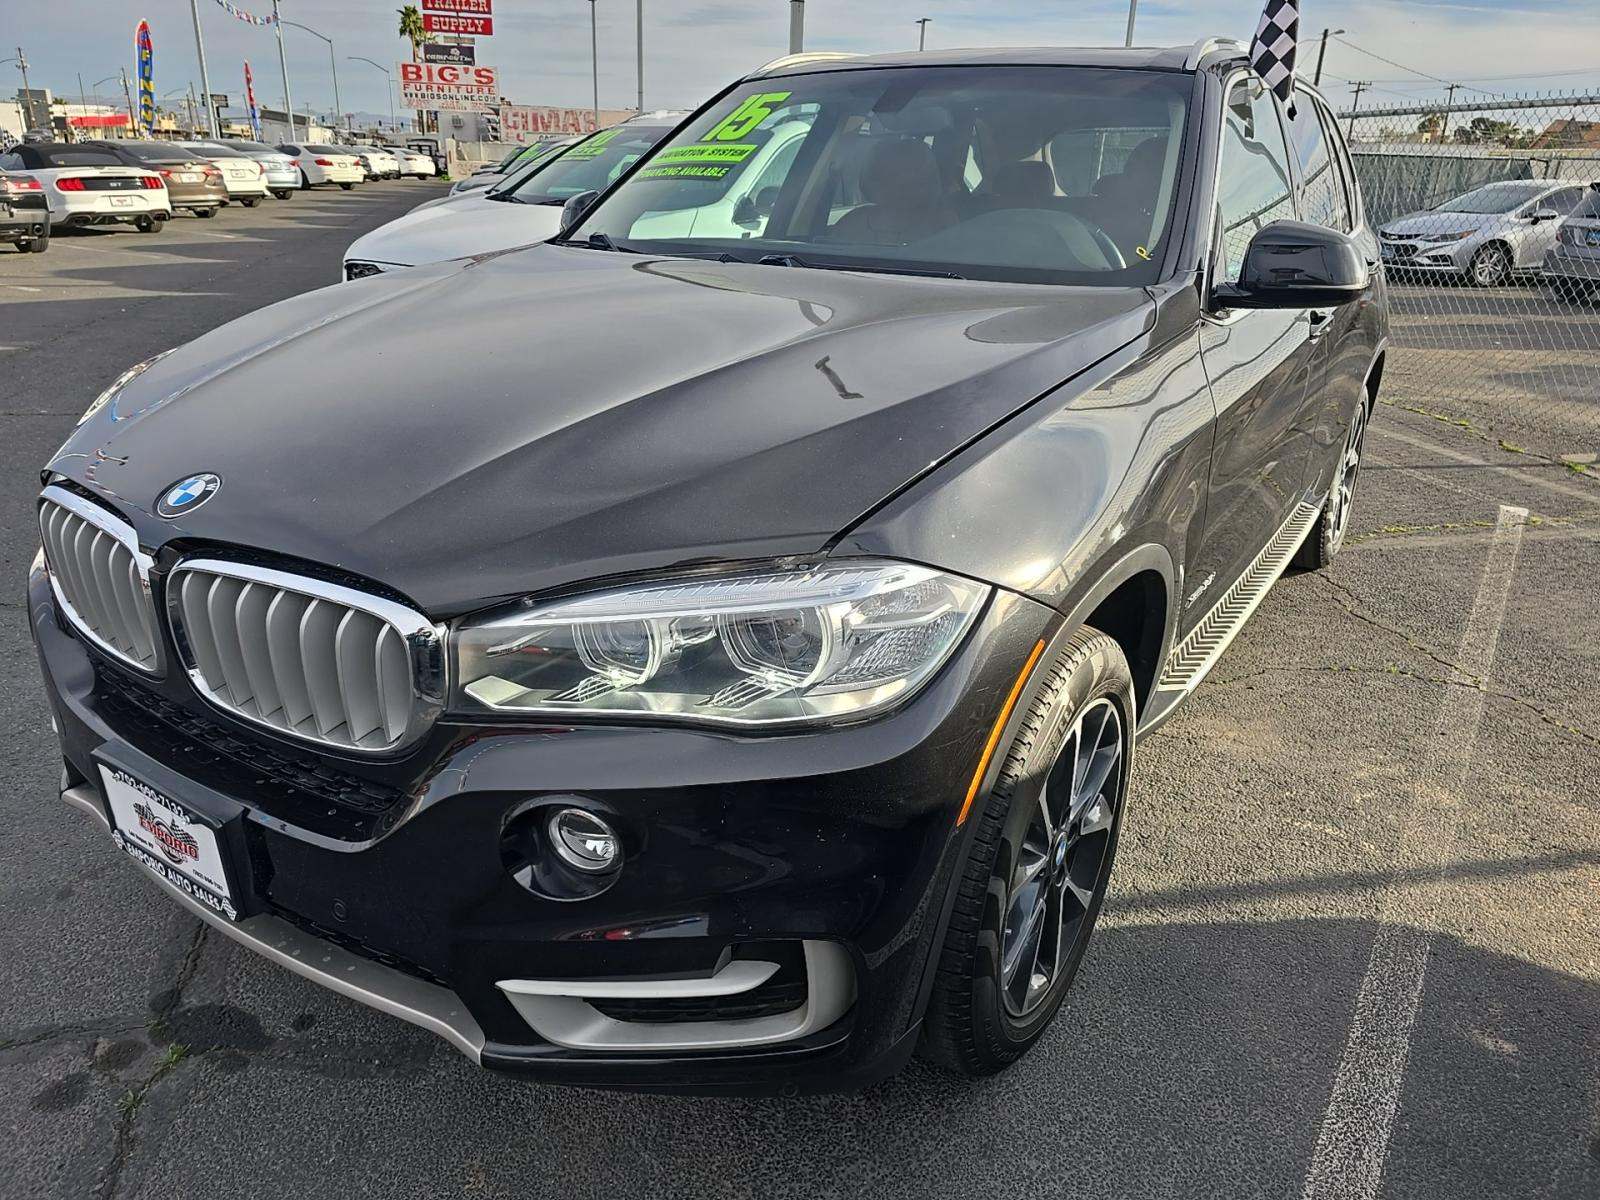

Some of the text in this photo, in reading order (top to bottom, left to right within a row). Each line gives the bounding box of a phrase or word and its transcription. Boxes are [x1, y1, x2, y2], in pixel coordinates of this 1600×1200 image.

[427, 0, 488, 12] TRAILER
[432, 16, 484, 32] SUPPLY
[401, 64, 494, 84] BIG'S
[403, 84, 495, 95] FURNITURE
[699, 92, 792, 141] 15
[708, 147, 750, 157] SYSTEM
[678, 167, 731, 177] AVAILABLE
[140, 816, 199, 861] EMPORIO
[127, 843, 166, 876] EMPORIO
[168, 868, 192, 893] AUTO
[193, 885, 220, 911] SALES
